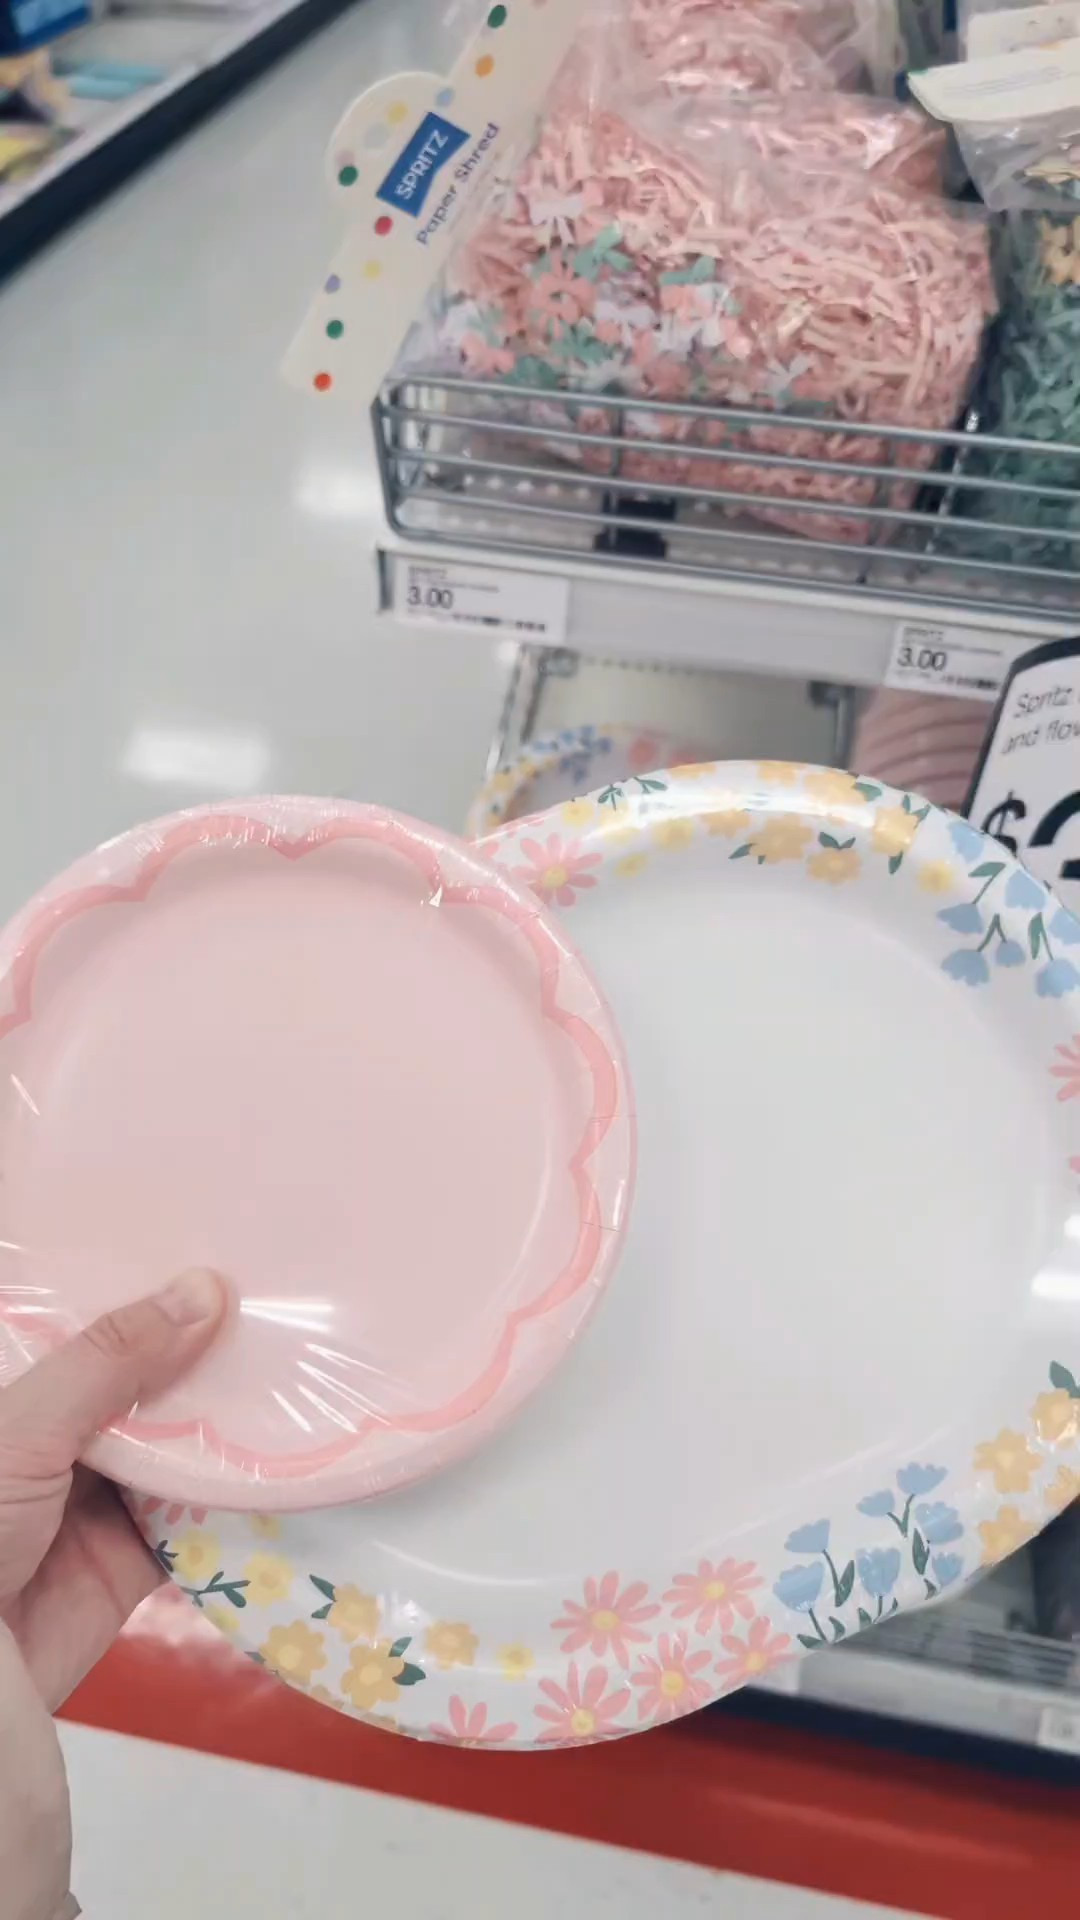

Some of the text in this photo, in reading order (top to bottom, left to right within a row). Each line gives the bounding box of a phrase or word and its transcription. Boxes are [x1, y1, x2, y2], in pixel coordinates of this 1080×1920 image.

[394, 129, 449, 200] SPRITZ
[416, 122, 500, 245] Paper Shred
[407, 586, 454, 609] 3.00
[897, 647, 947, 672] 3.00
